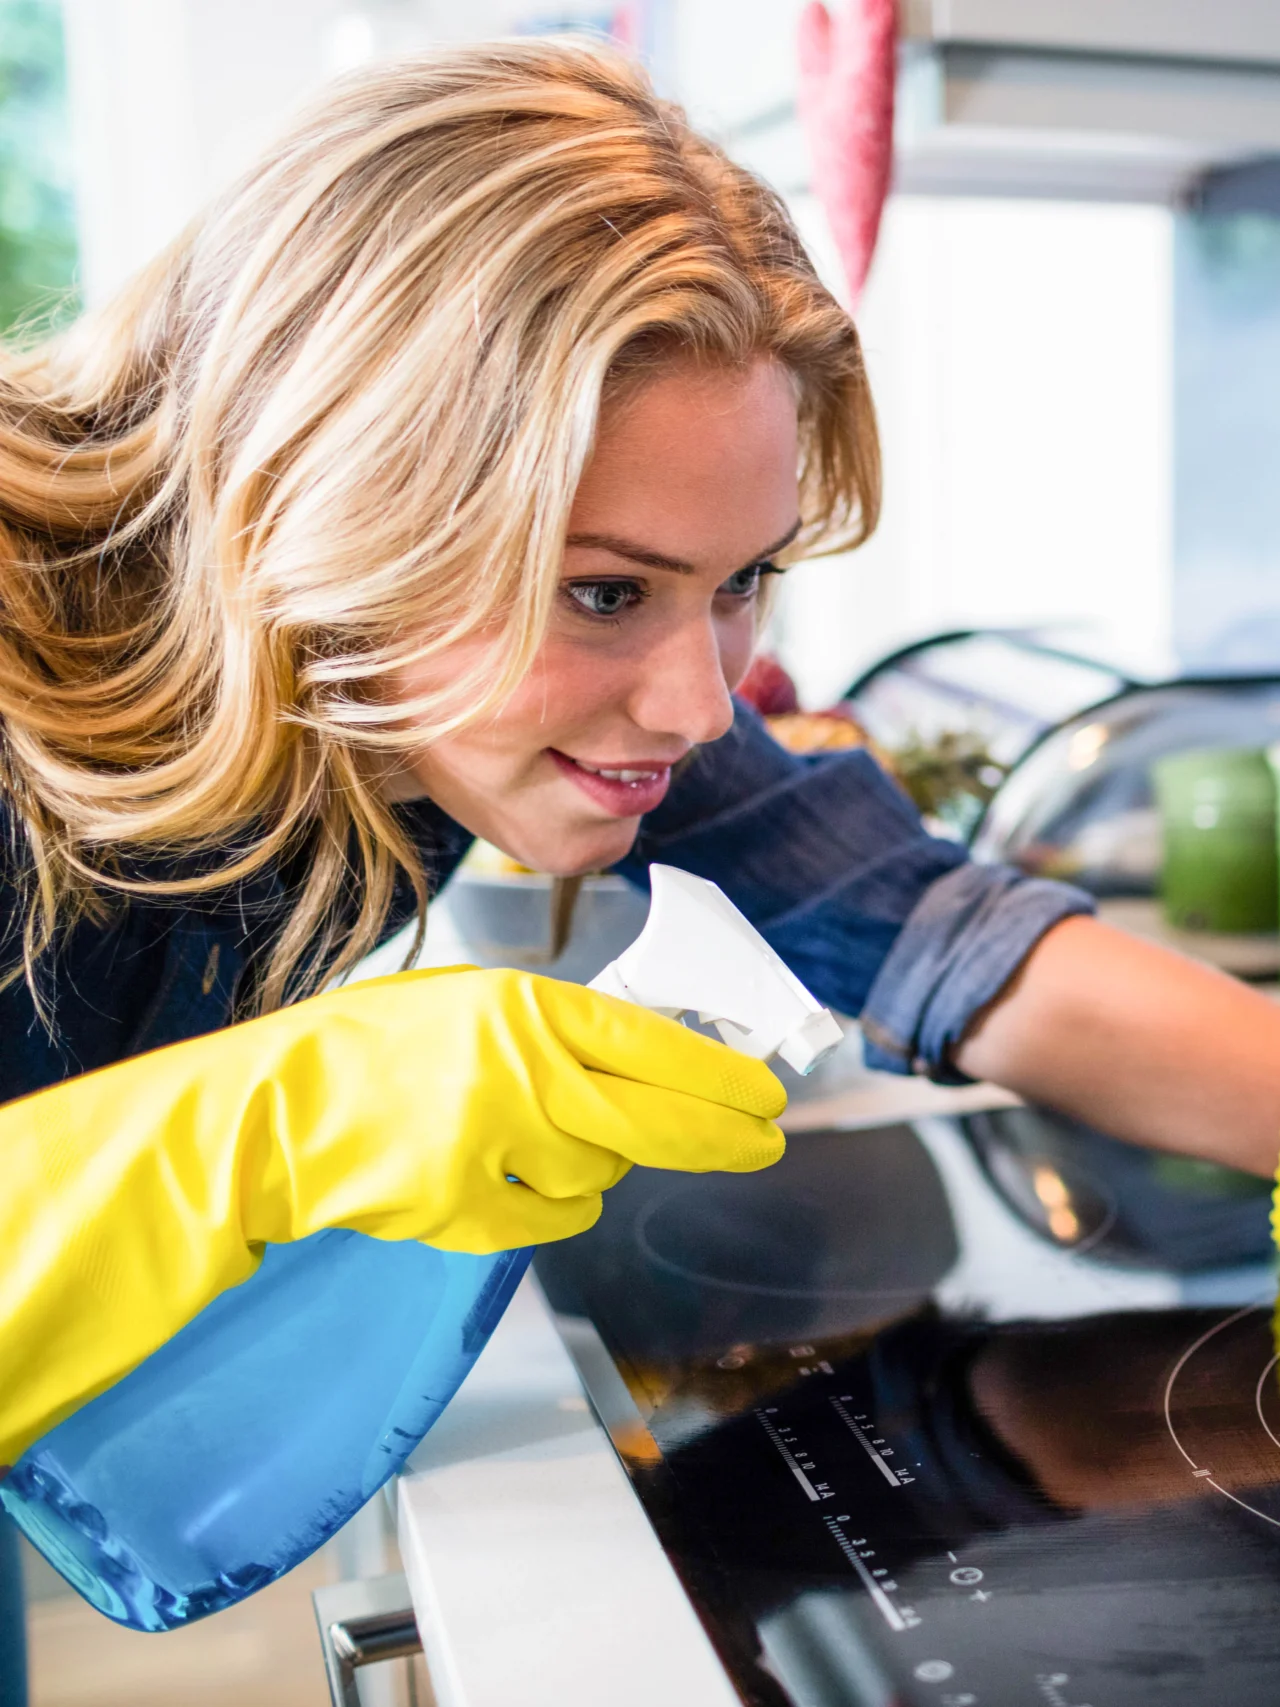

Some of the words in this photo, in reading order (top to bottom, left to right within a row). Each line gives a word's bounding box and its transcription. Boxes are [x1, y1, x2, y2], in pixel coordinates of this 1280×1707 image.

[880, 1448, 894, 1456] 10
[801, 1462, 816, 1470] 10
[814, 1482, 830, 1491] 14
